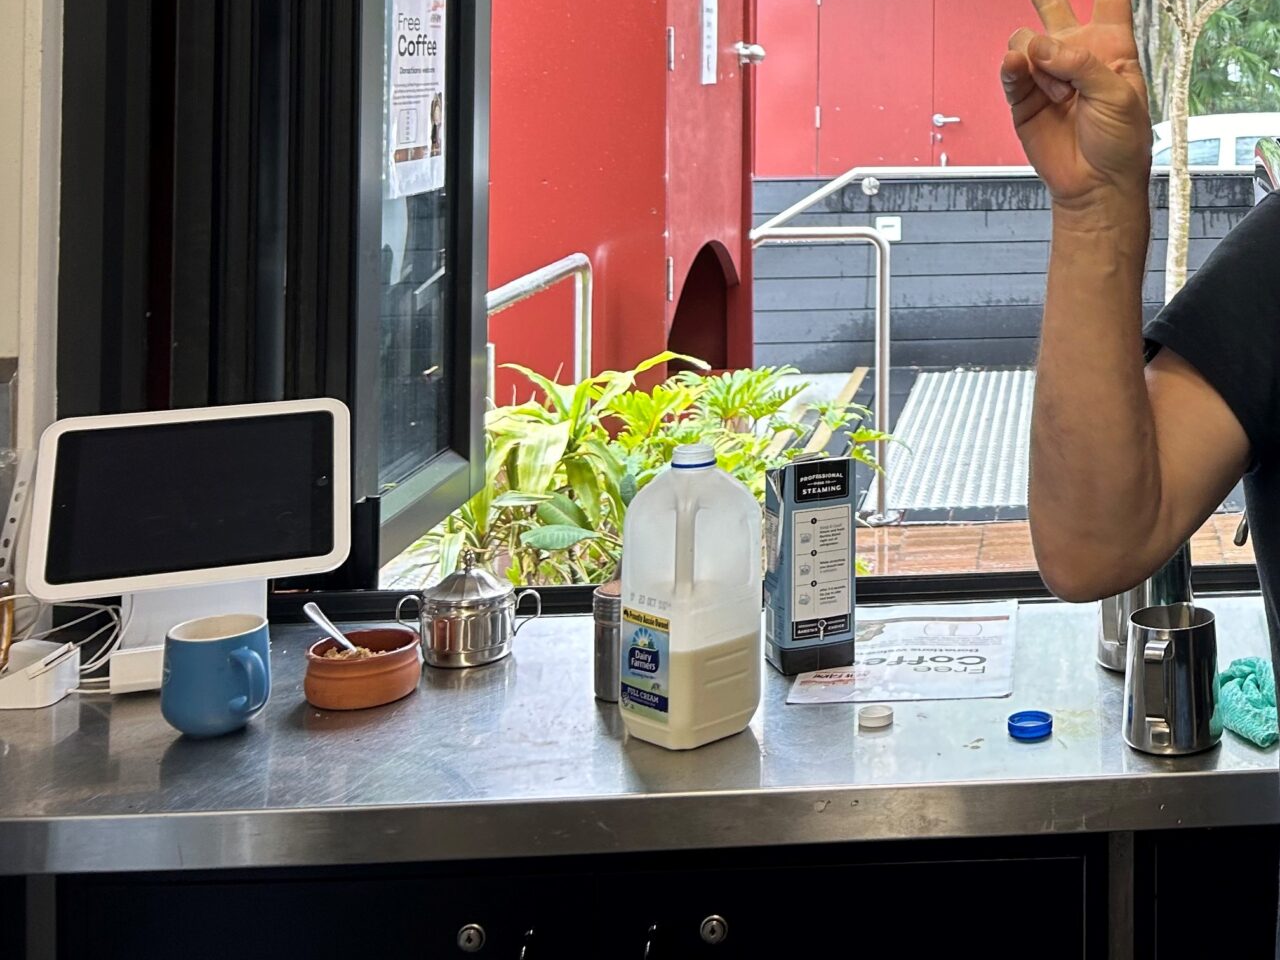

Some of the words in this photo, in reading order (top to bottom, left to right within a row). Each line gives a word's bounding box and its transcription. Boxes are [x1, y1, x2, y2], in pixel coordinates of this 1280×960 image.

[397, 12, 421, 32] Free
[397, 33, 437, 57] Coffee
[800, 472, 844, 483] PROFESSIONAL
[802, 484, 842, 495] STEAMING
[634, 649, 652, 662] Dairy
[630, 657, 656, 671] Farmers
[912, 665, 987, 675] Free
[627, 686, 640, 697] FULL
[639, 691, 659, 704] CREAM
